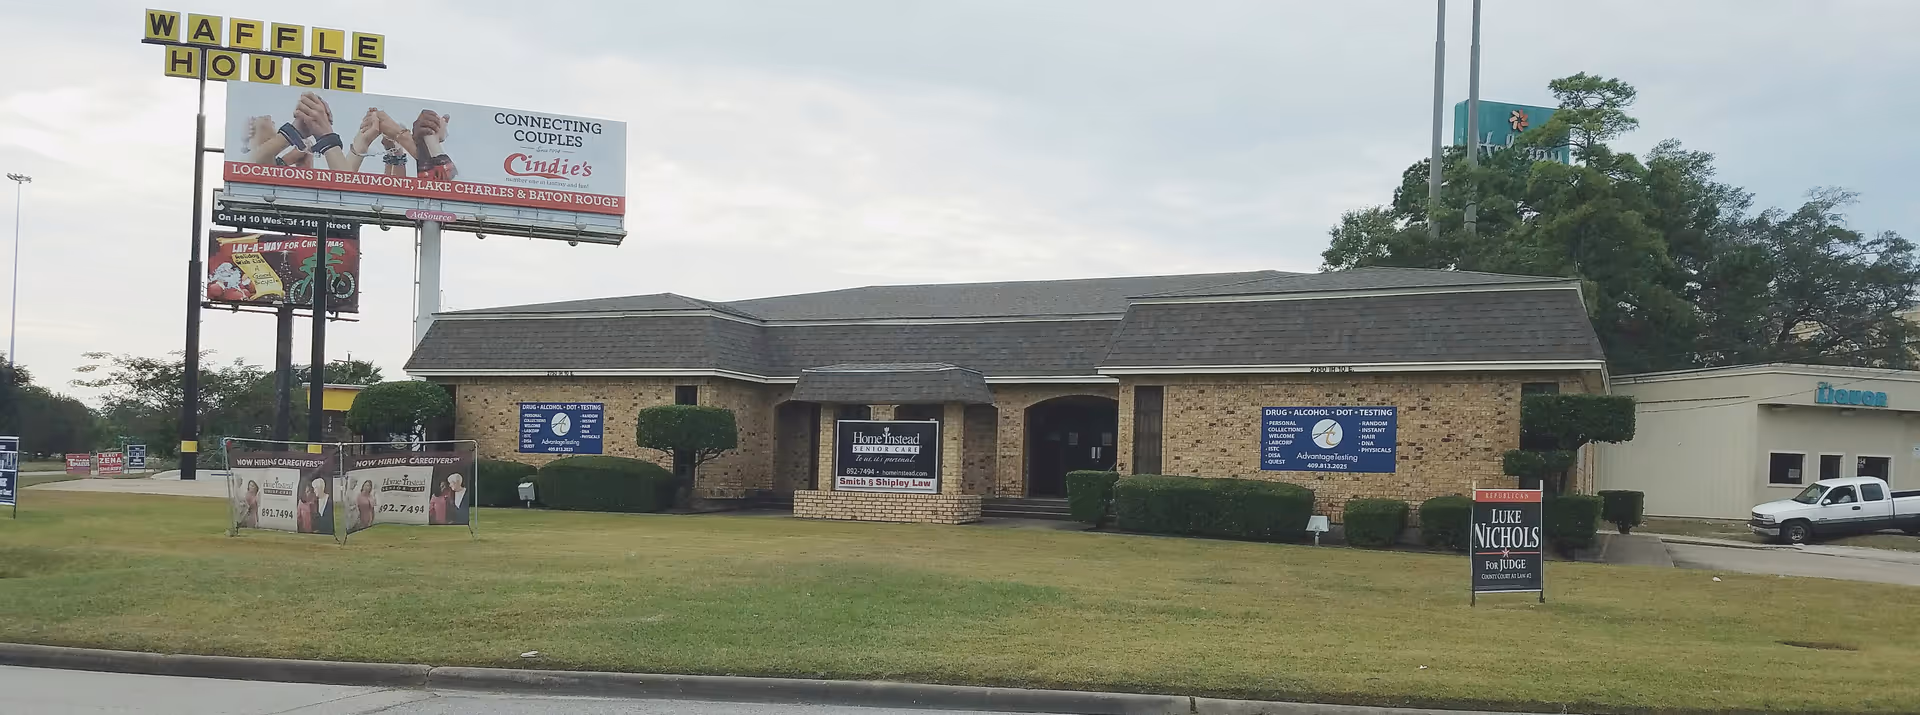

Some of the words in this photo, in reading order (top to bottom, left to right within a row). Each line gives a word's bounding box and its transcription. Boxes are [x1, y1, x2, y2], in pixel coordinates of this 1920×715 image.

[150, 13, 378, 58] WAFFLE
[171, 50, 356, 90] HOUSE
[494, 112, 602, 134] CONNECTING
[514, 130, 583, 148] COUPLES
[504, 152, 592, 180] Cindie's
[232, 164, 313, 180] LOCATIONS
[316, 172, 332, 182] IN
[335, 173, 415, 191] BEAUMONT,
[417, 180, 452, 192] LAKE
[454, 183, 514, 198] CHARLES
[517, 190, 526, 199] &
[529, 190, 572, 203] BATON
[575, 195, 619, 208] ROUGE
[410, 210, 452, 221] AdSource
[232, 242, 282, 252] LAY-A-WAY
[284, 240, 299, 249] FOR
[853, 432, 882, 444] Home
[237, 458, 252, 466] NOW
[254, 458, 277, 466] HIRING
[356, 459, 377, 468] NOW
[377, 457, 407, 465] HIRING
[1296, 452, 1358, 462] AdvantageTesting
[840, 477, 866, 485] Smith
[875, 479, 909, 488] Shipley
[262, 508, 293, 518] 892.7494
[1492, 508, 1522, 524] LUKE
[1475, 523, 1540, 548] NICHOLS
